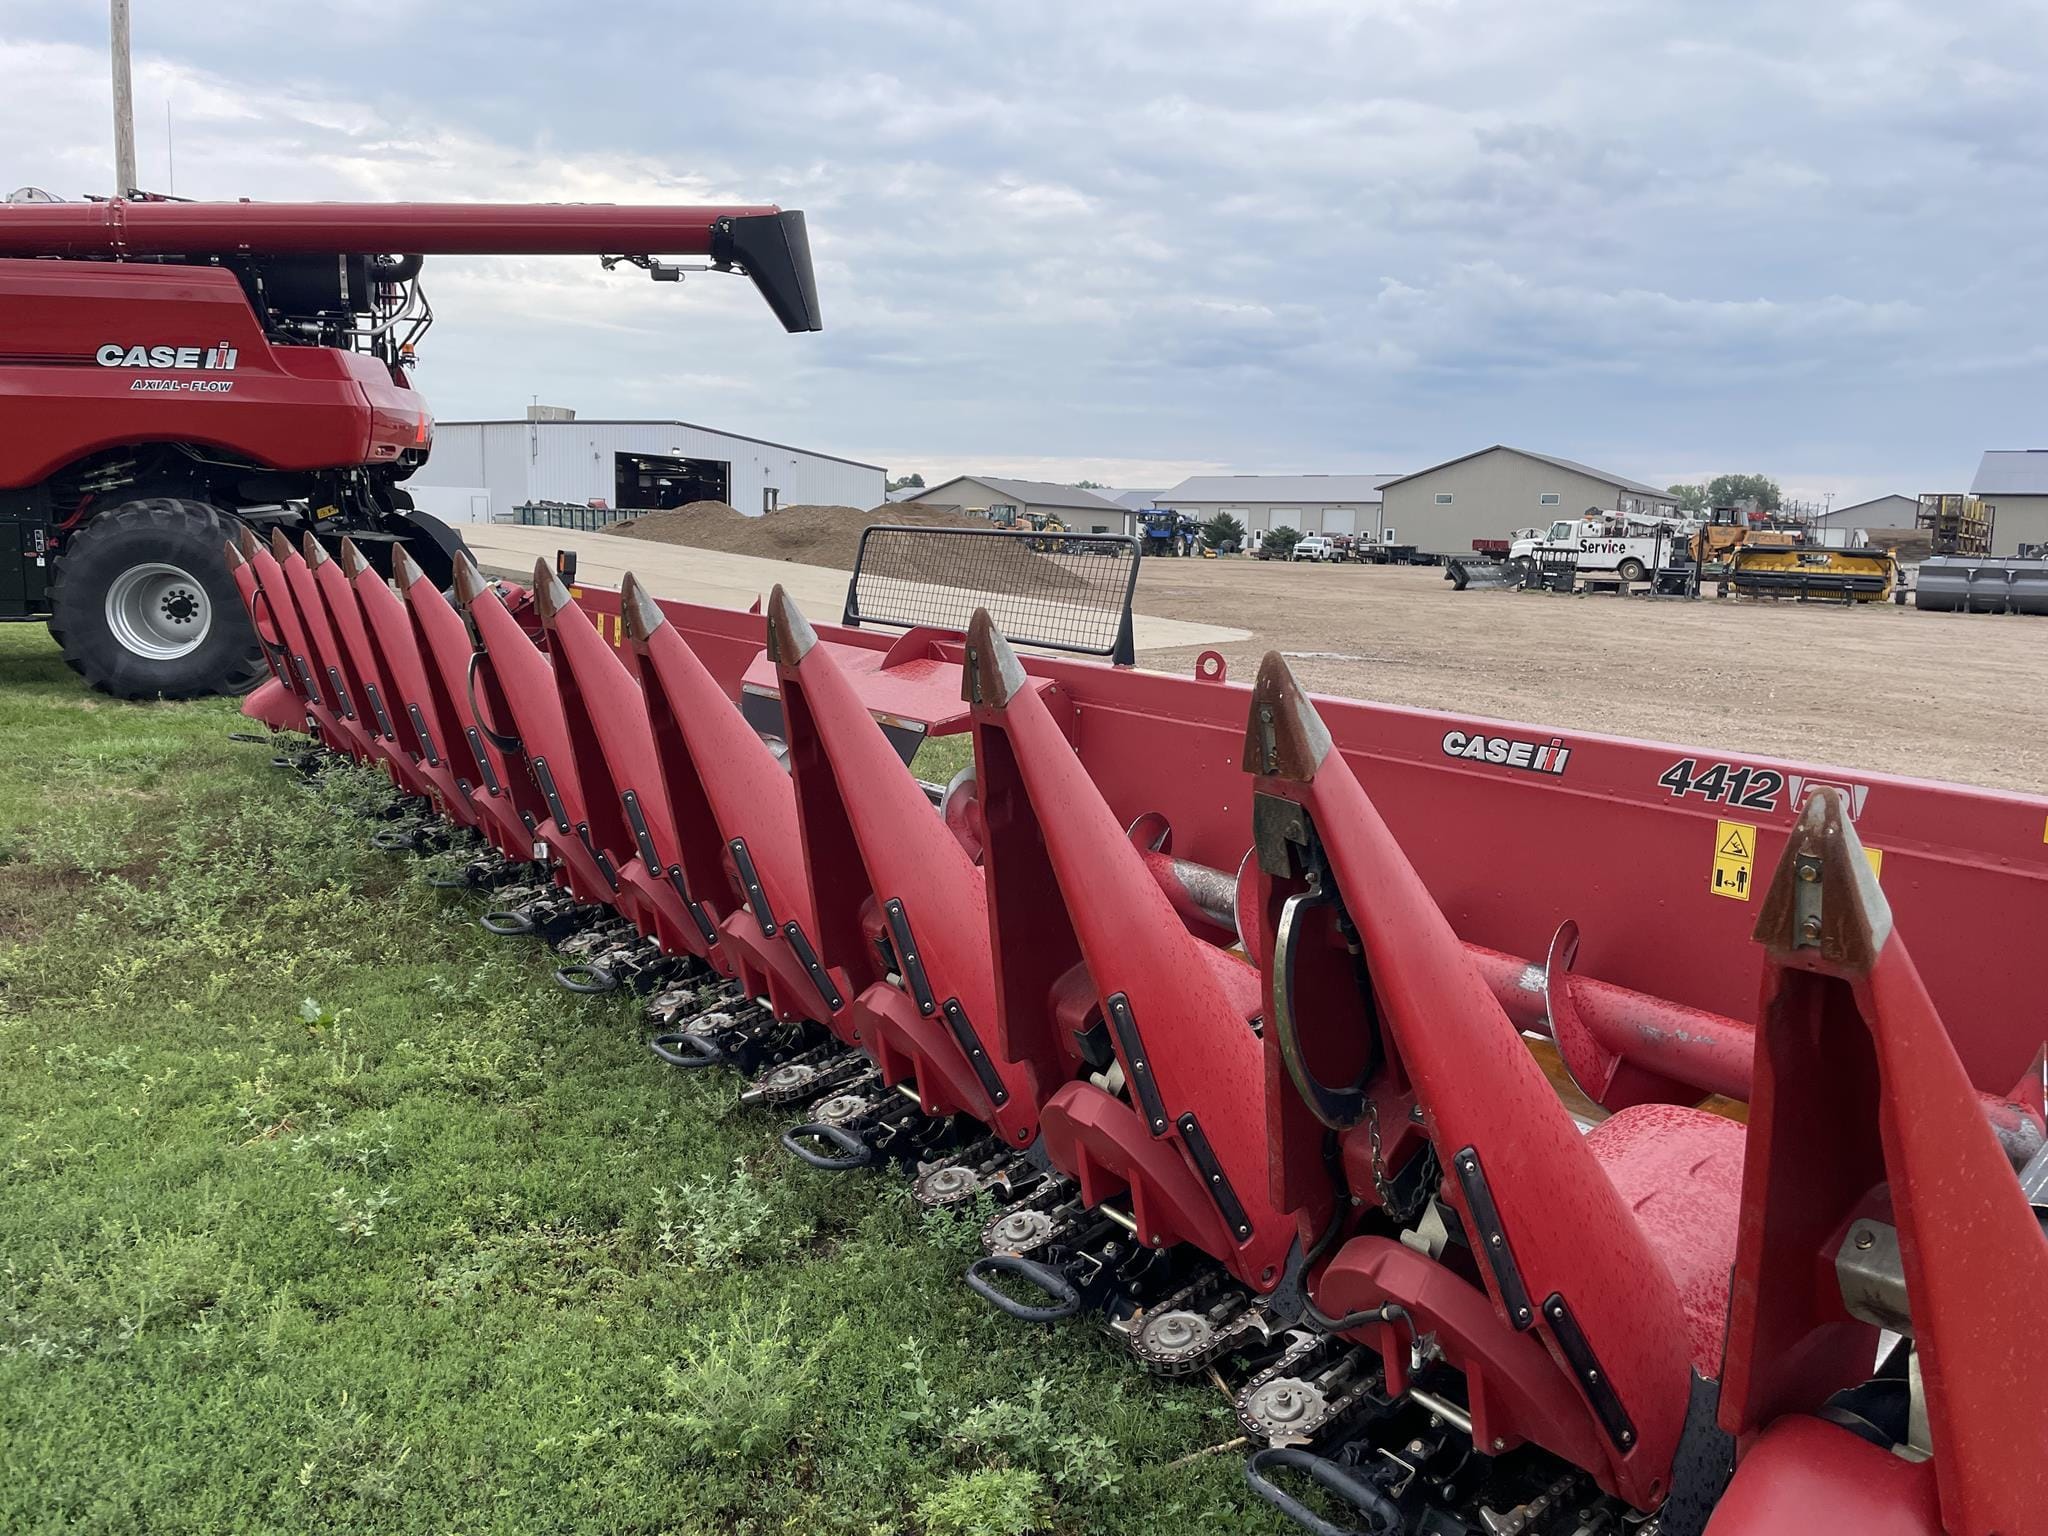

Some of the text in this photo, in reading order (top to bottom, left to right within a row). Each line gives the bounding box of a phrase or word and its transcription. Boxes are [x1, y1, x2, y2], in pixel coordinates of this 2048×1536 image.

[96, 344, 201, 368] CASE
[1579, 539, 1626, 554] Service
[1443, 731, 1535, 767] CASE
[1657, 758, 1783, 813] 4412
